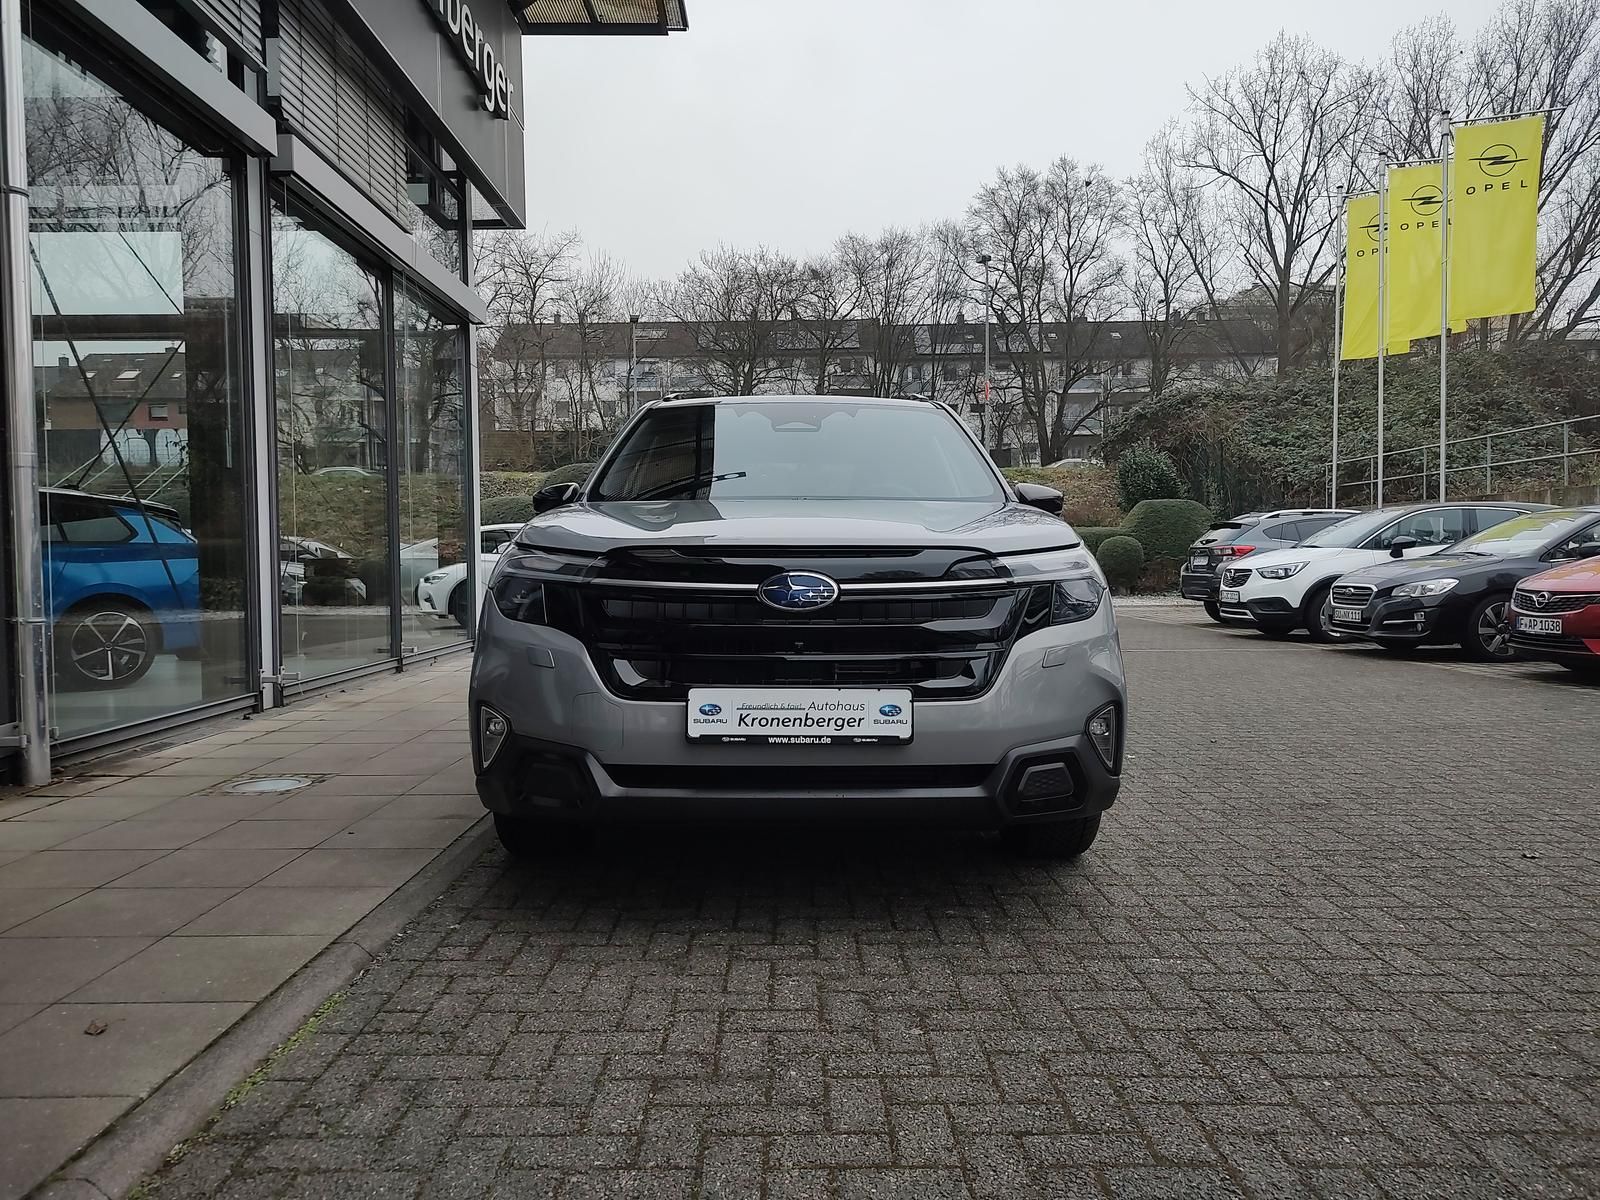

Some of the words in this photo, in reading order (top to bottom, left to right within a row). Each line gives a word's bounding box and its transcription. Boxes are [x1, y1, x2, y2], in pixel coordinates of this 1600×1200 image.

[1466, 179, 1528, 195] OPEL
[808, 700, 866, 712] Autohaus
[738, 712, 865, 732] Kronenberger
[768, 735, 832, 744] www.subaru.de
